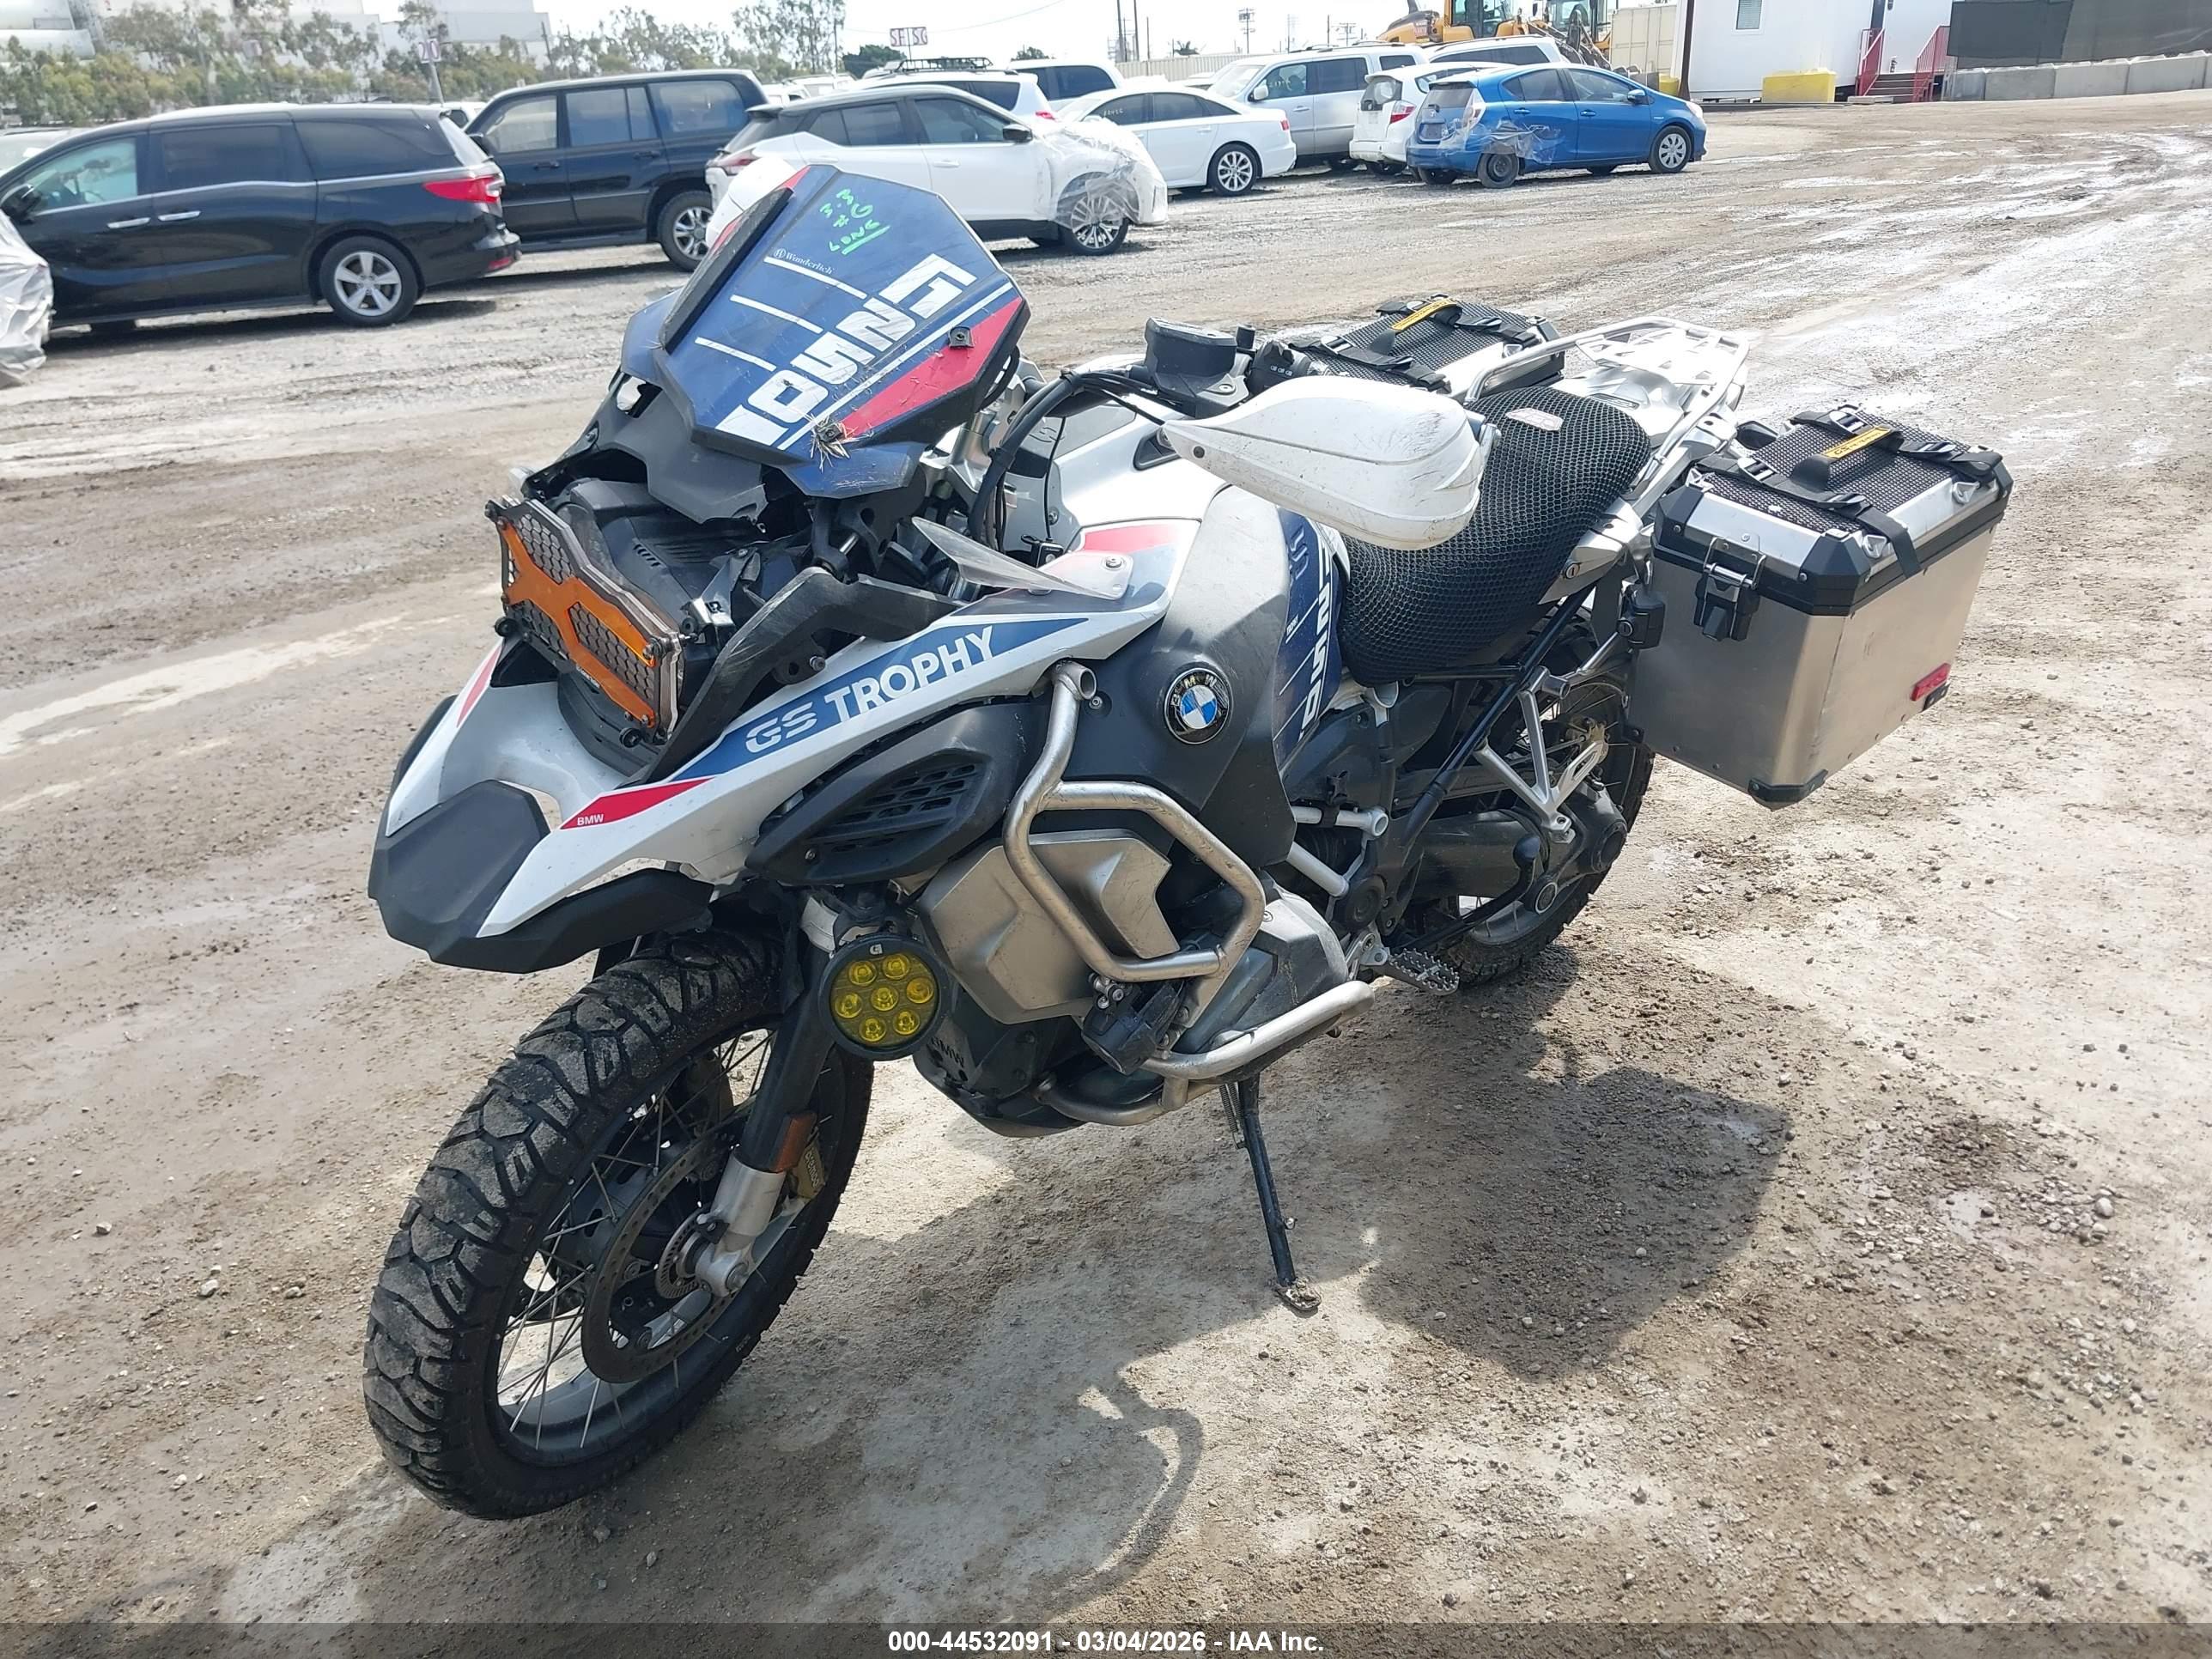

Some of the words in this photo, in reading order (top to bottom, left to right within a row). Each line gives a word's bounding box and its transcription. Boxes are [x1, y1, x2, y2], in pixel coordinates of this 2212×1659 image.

[785, 252, 836, 275] Wunderlich
[745, 701, 817, 753] GS
[823, 625, 994, 722] TROPHY
[1170, 673, 1218, 707] BMW
[577, 813, 605, 826] BMW
